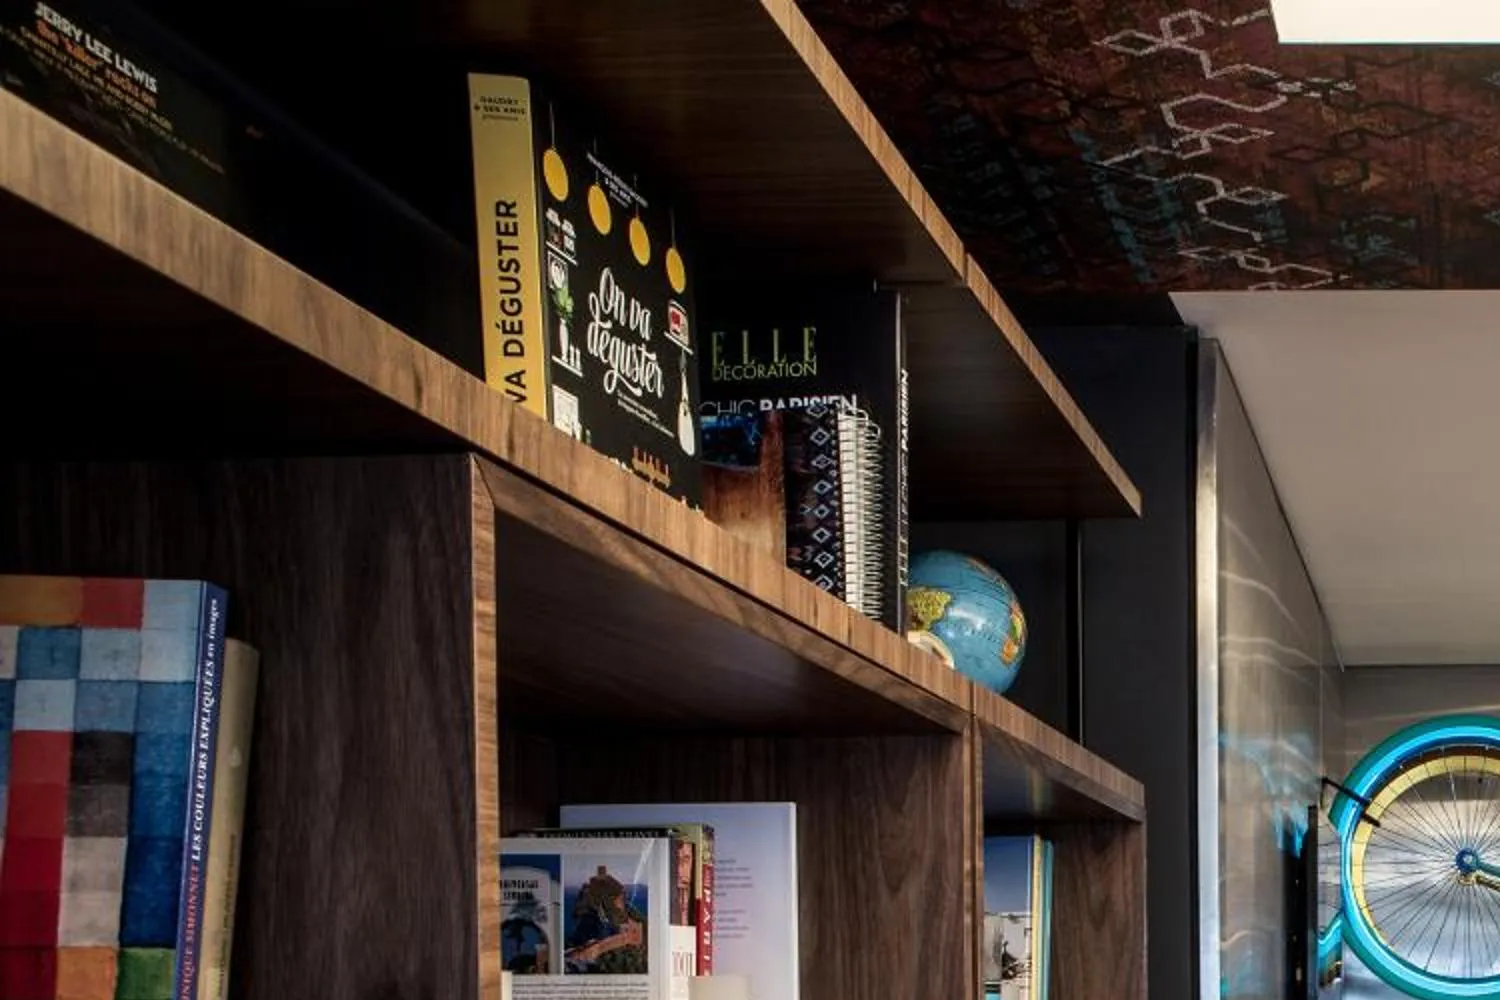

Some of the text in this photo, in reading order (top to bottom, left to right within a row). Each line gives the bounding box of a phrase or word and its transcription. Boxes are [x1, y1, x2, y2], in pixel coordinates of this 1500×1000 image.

[35, 1, 158, 93] JERRY LEE LEWIS
[495, 200, 524, 358] DÉGUSTER
[600, 267, 652, 341] On va
[712, 327, 817, 368] ELLE
[760, 394, 857, 416] PARISIEN
[207, 598, 219, 640] images
[194, 752, 209, 832] COULEURS
[192, 834, 203, 862] LES
